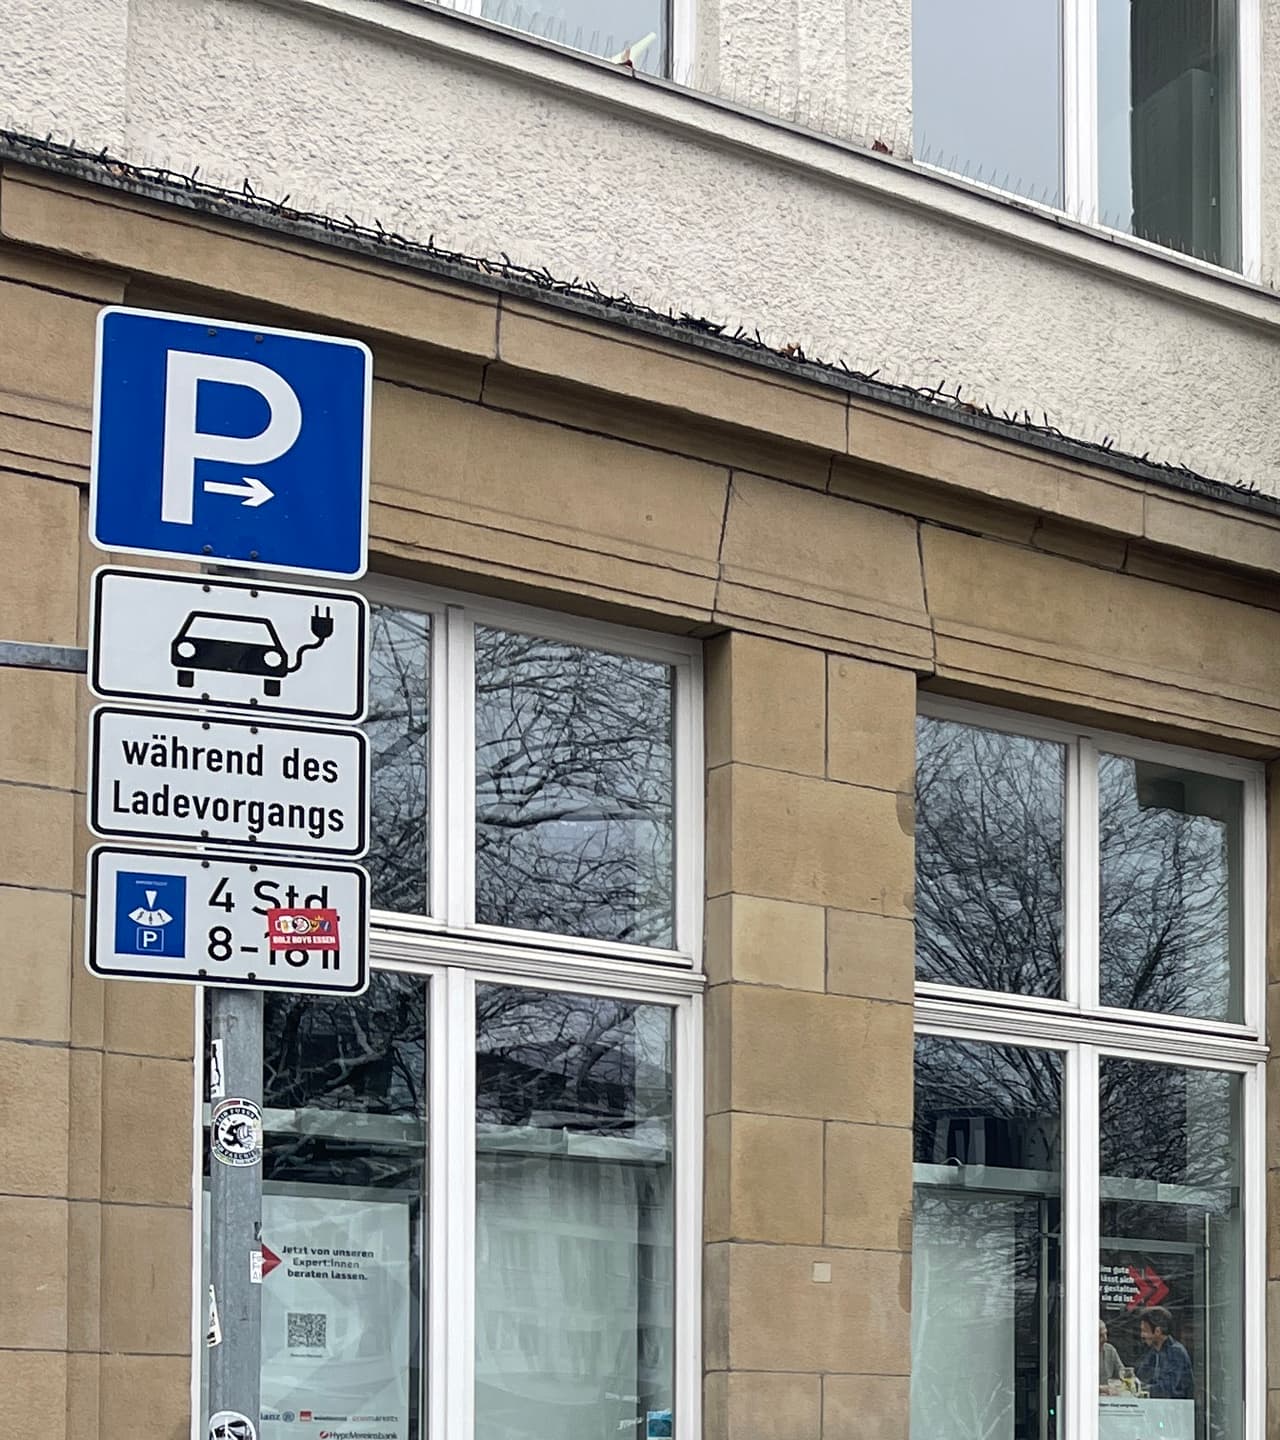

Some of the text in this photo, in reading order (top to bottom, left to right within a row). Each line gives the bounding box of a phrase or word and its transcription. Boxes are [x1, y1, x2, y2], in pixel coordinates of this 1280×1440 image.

[161, 349, 302, 525] P
[122, 733, 339, 783] während des
[112, 780, 345, 836] Ladevorgangs
[208, 877, 235, 912] 4
[282, 1245, 308, 1254] Jetzt
[333, 1249, 374, 1258] unseren
[287, 1269, 328, 1279] beraten
